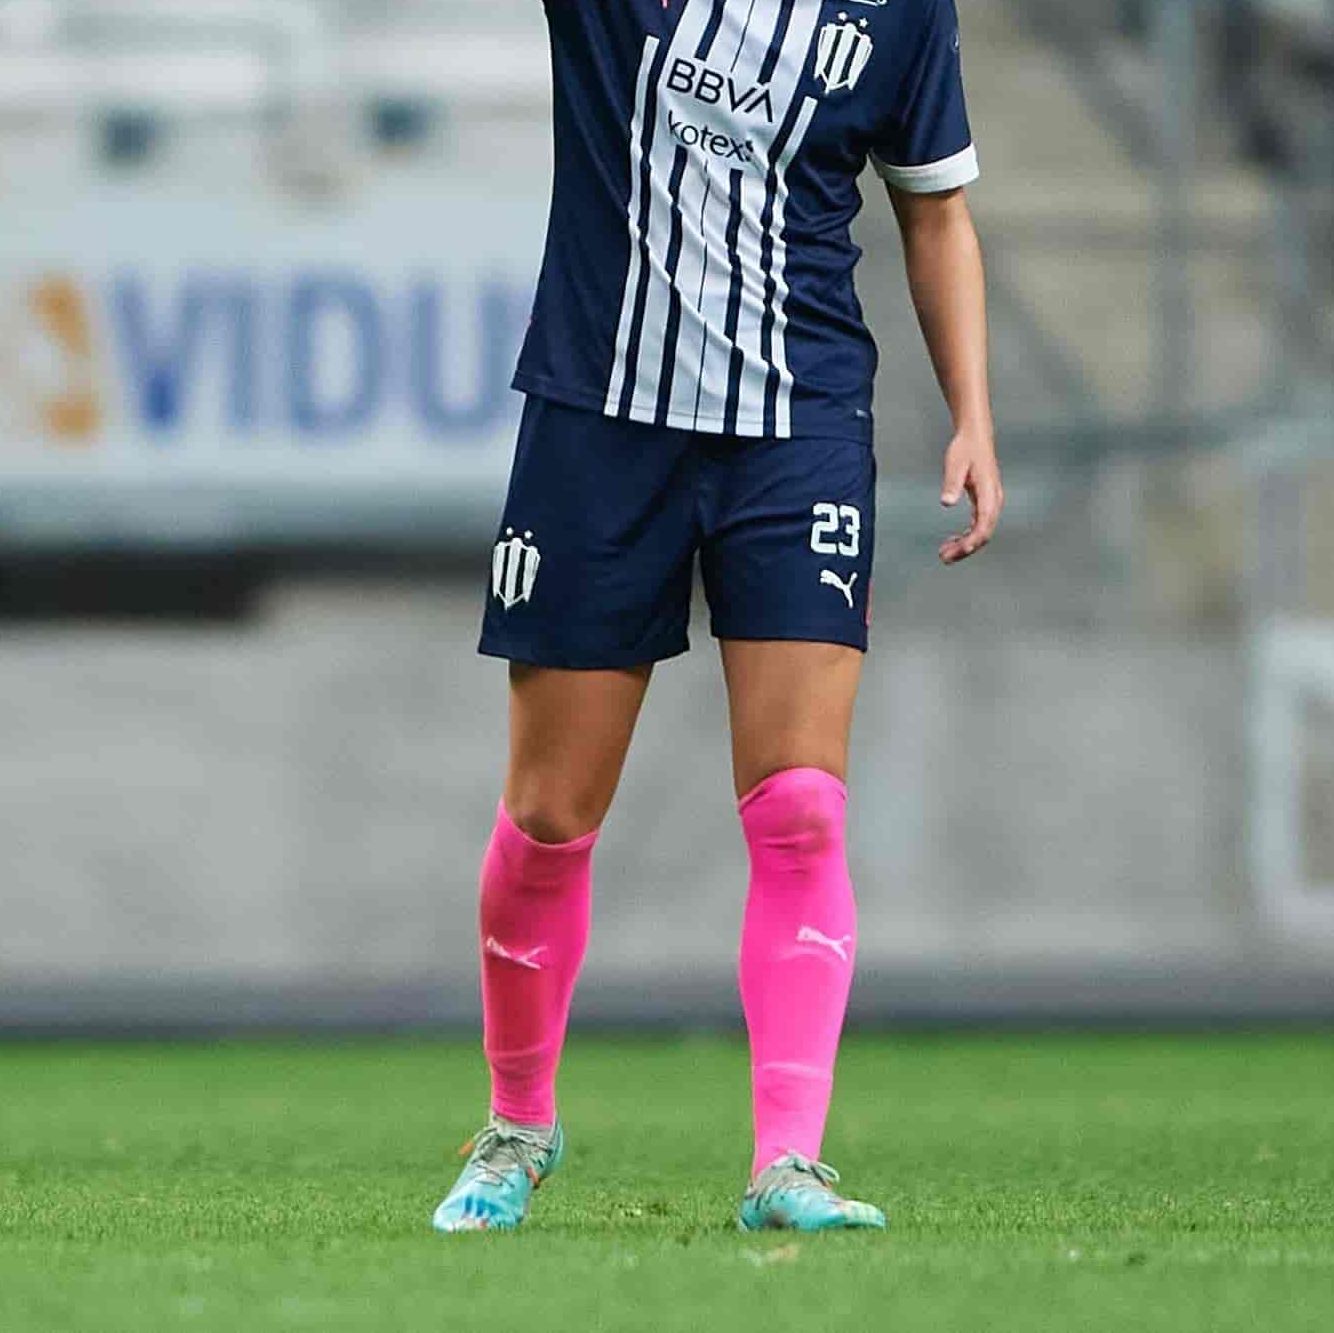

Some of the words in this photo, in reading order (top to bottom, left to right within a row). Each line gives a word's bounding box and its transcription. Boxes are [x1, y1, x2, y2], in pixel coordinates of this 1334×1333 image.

[667, 57, 773, 123] BBVA
[668, 109, 745, 162] kotex
[115, 270, 525, 438] VIDU
[810, 502, 861, 557] 23
